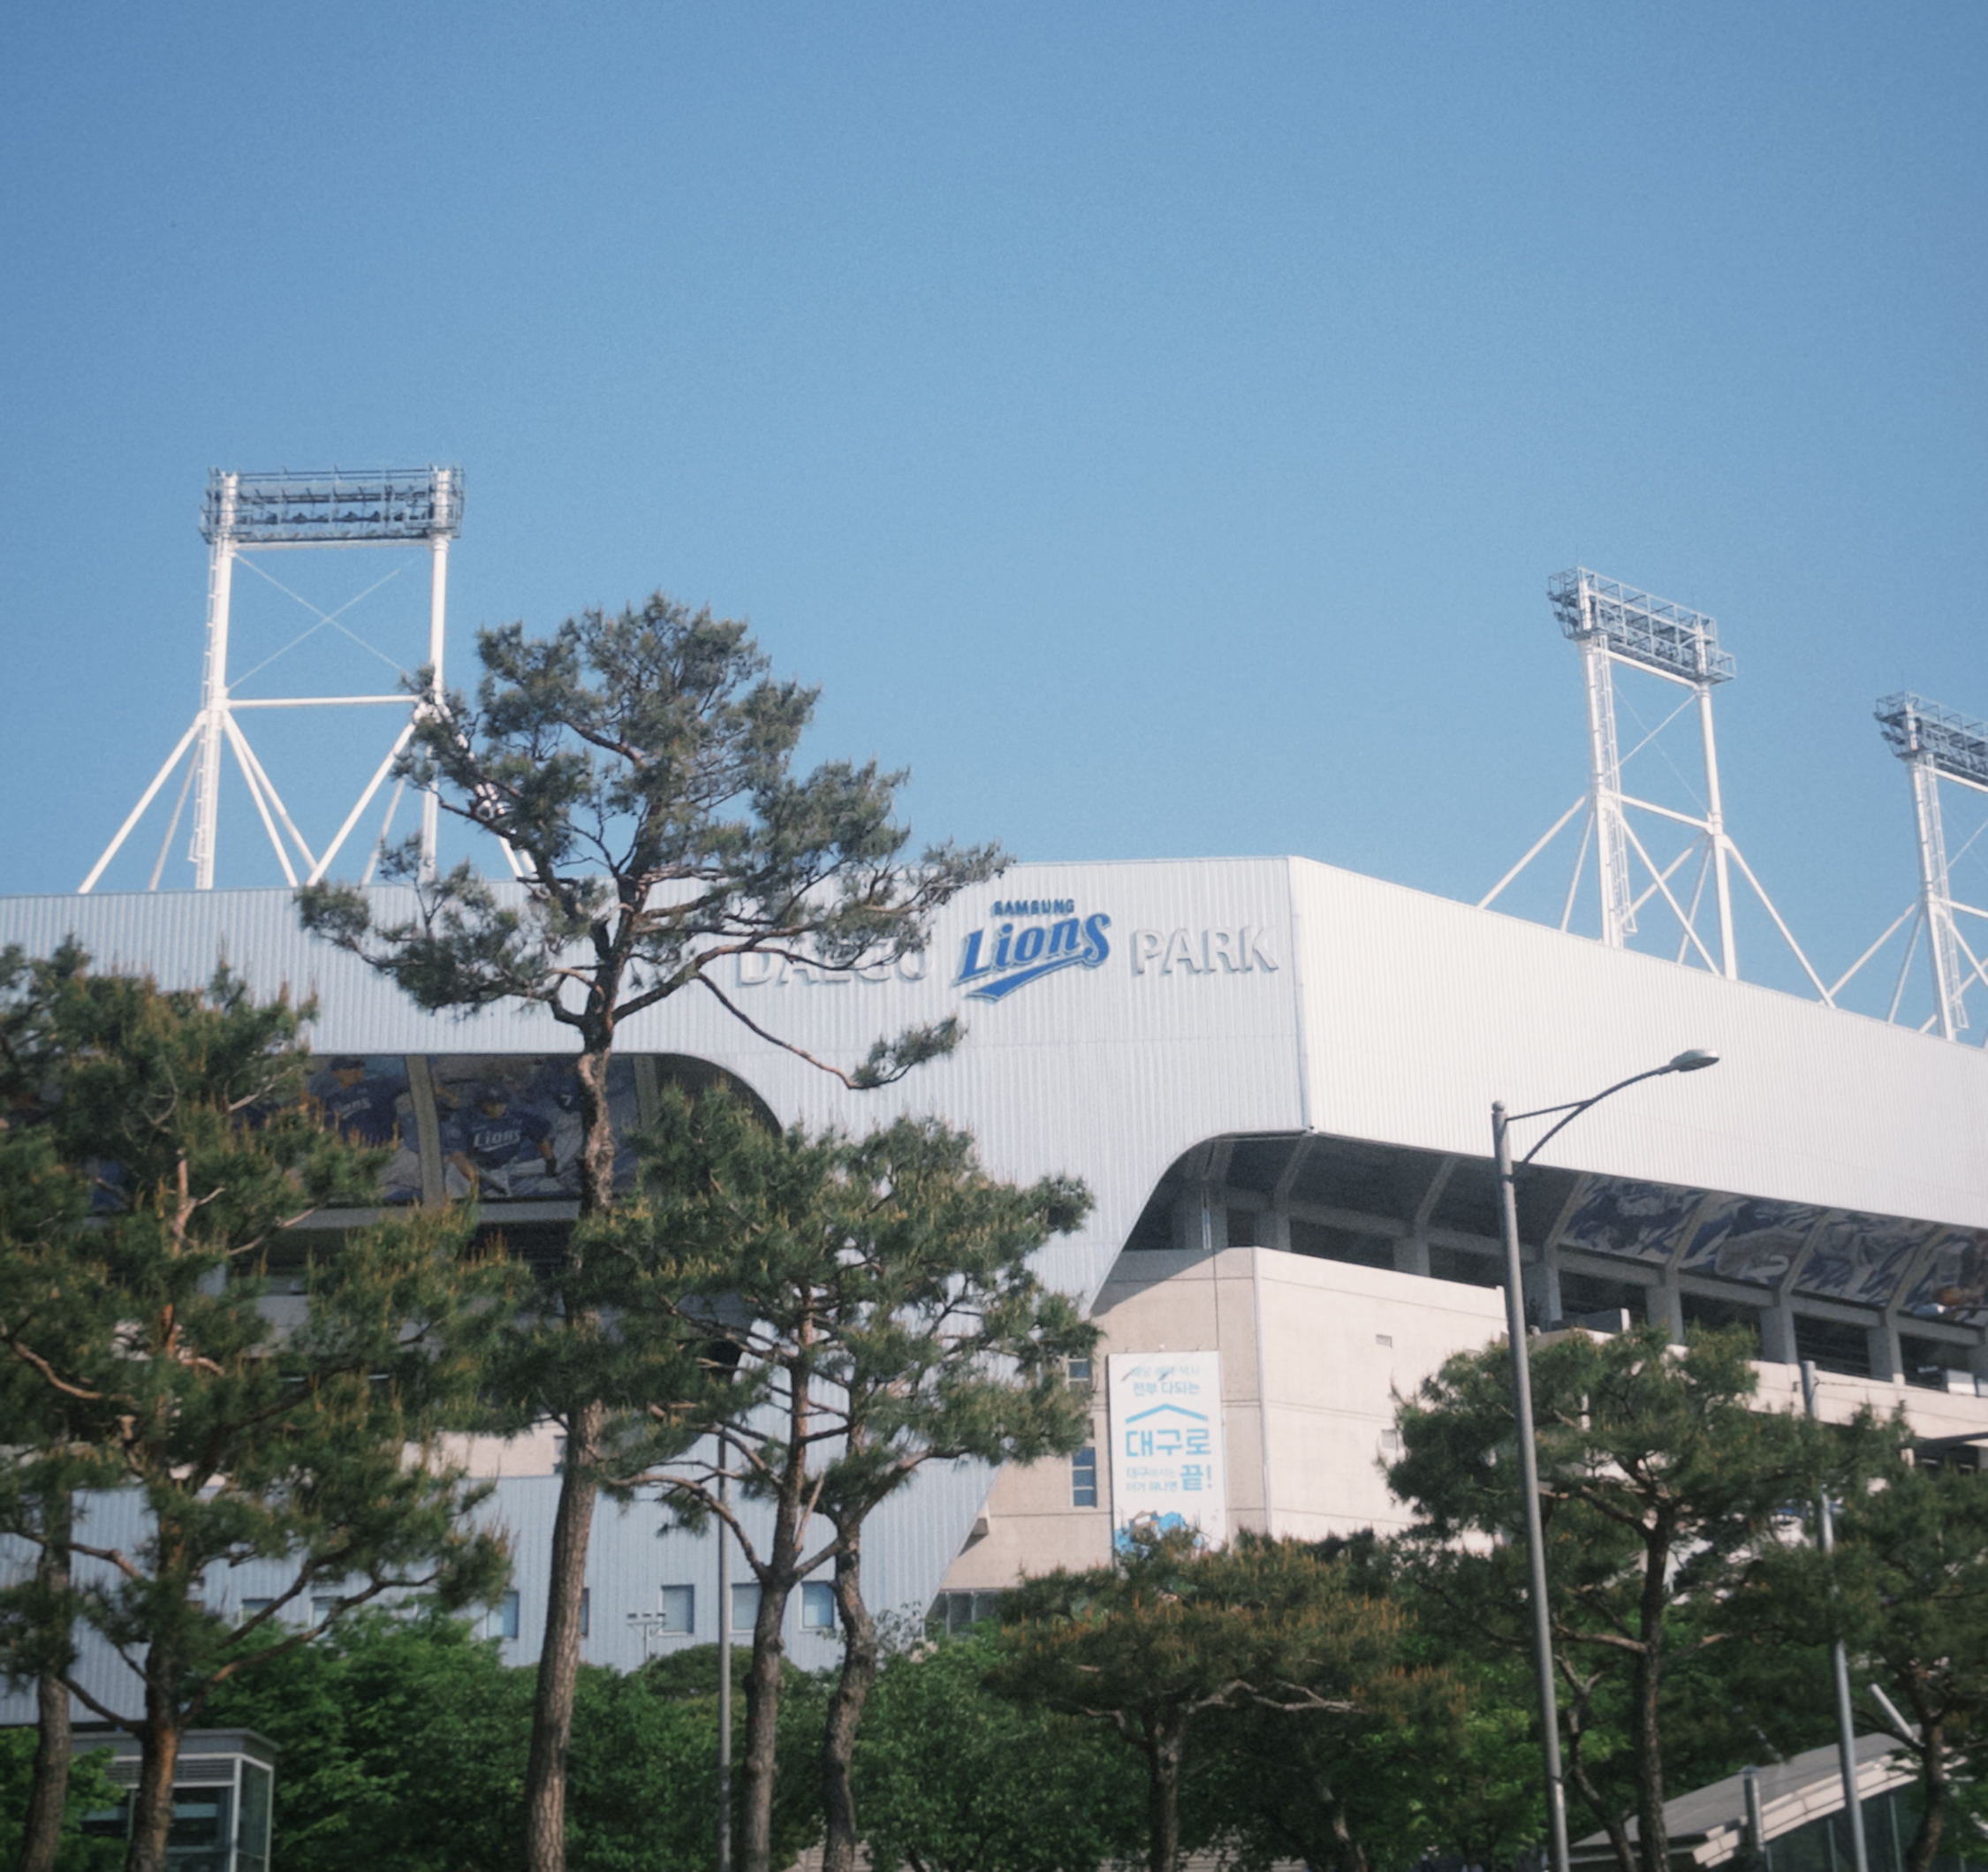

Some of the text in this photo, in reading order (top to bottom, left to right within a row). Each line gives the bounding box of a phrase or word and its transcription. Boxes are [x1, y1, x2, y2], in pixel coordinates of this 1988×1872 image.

[990, 898, 1075, 916] SAMSUNG
[952, 913, 1112, 989] Lions
[1130, 927, 1279, 977] PARK
[473, 1128, 521, 1152] Lions
[1125, 1428, 1211, 1458] 대구로
[1180, 1464, 1213, 1491] 끝!
